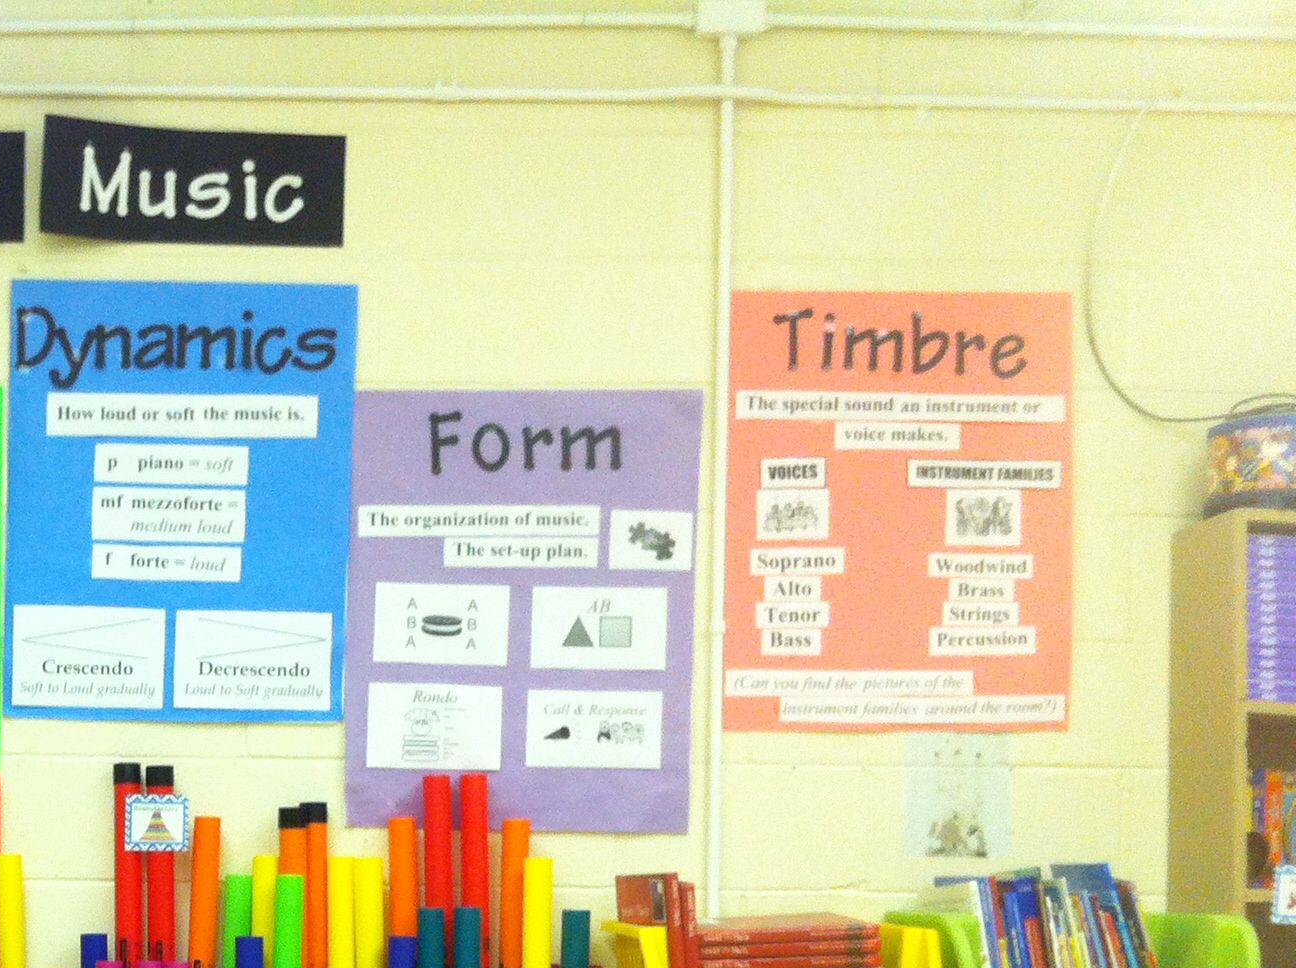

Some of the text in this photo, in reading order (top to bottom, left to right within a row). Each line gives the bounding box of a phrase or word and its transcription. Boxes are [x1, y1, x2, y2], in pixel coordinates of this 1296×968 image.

[79, 143, 304, 222] Music
[15, 305, 337, 389] Dynamics
[773, 308, 1027, 378] Timbre
[745, 396, 1040, 414] The special sound an instrument or
[57, 406, 305, 423] How loud or soft the music is.
[844, 427, 948, 442] voice makes.
[428, 411, 622, 476] Form
[108, 455, 234, 474] p piano soft
[768, 464, 818, 481] VOICES
[916, 465, 1054, 482] INSTRUMENT FAMILIES
[101, 495, 223, 512] mf mezzoforte
[130, 519, 233, 536] medium loud
[367, 512, 589, 529] The organization of music.
[453, 542, 588, 560] The set-up plan.
[104, 553, 227, 573] f forte loud
[757, 553, 836, 571] Soprano
[935, 559, 1027, 574] Woodwind
[773, 582, 812, 597] Alto
[958, 583, 1004, 598] Brass
[407, 598, 418, 609] A
[467, 600, 478, 611] A
[588, 600, 611, 614] AB
[407, 617, 417, 629] B
[767, 608, 821, 623] Tenor
[949, 606, 1010, 624] Strings
[467, 619, 477, 631] B
[405, 636, 417, 648] A
[466, 638, 477, 649] A
[770, 632, 812, 647] Bass
[937, 632, 1028, 648] Percussion
[42, 660, 133, 677] Crescendo
[199, 661, 310, 679] Decrescendo
[20, 682, 155, 698] Soft to Loud gradually
[185, 682, 323, 699] Loud to Soft gradually
[775, 679, 799, 693] you
[803, 676, 832, 691] find
[835, 677, 855, 690] the
[862, 677, 920, 693] pictures
[924, 675, 940, 691] of
[943, 676, 963, 689] the
[412, 690, 458, 704] Rondo
[543, 704, 568, 716] Call
[588, 705, 647, 718] Response
[782, 700, 1003, 718] instrument families around the
